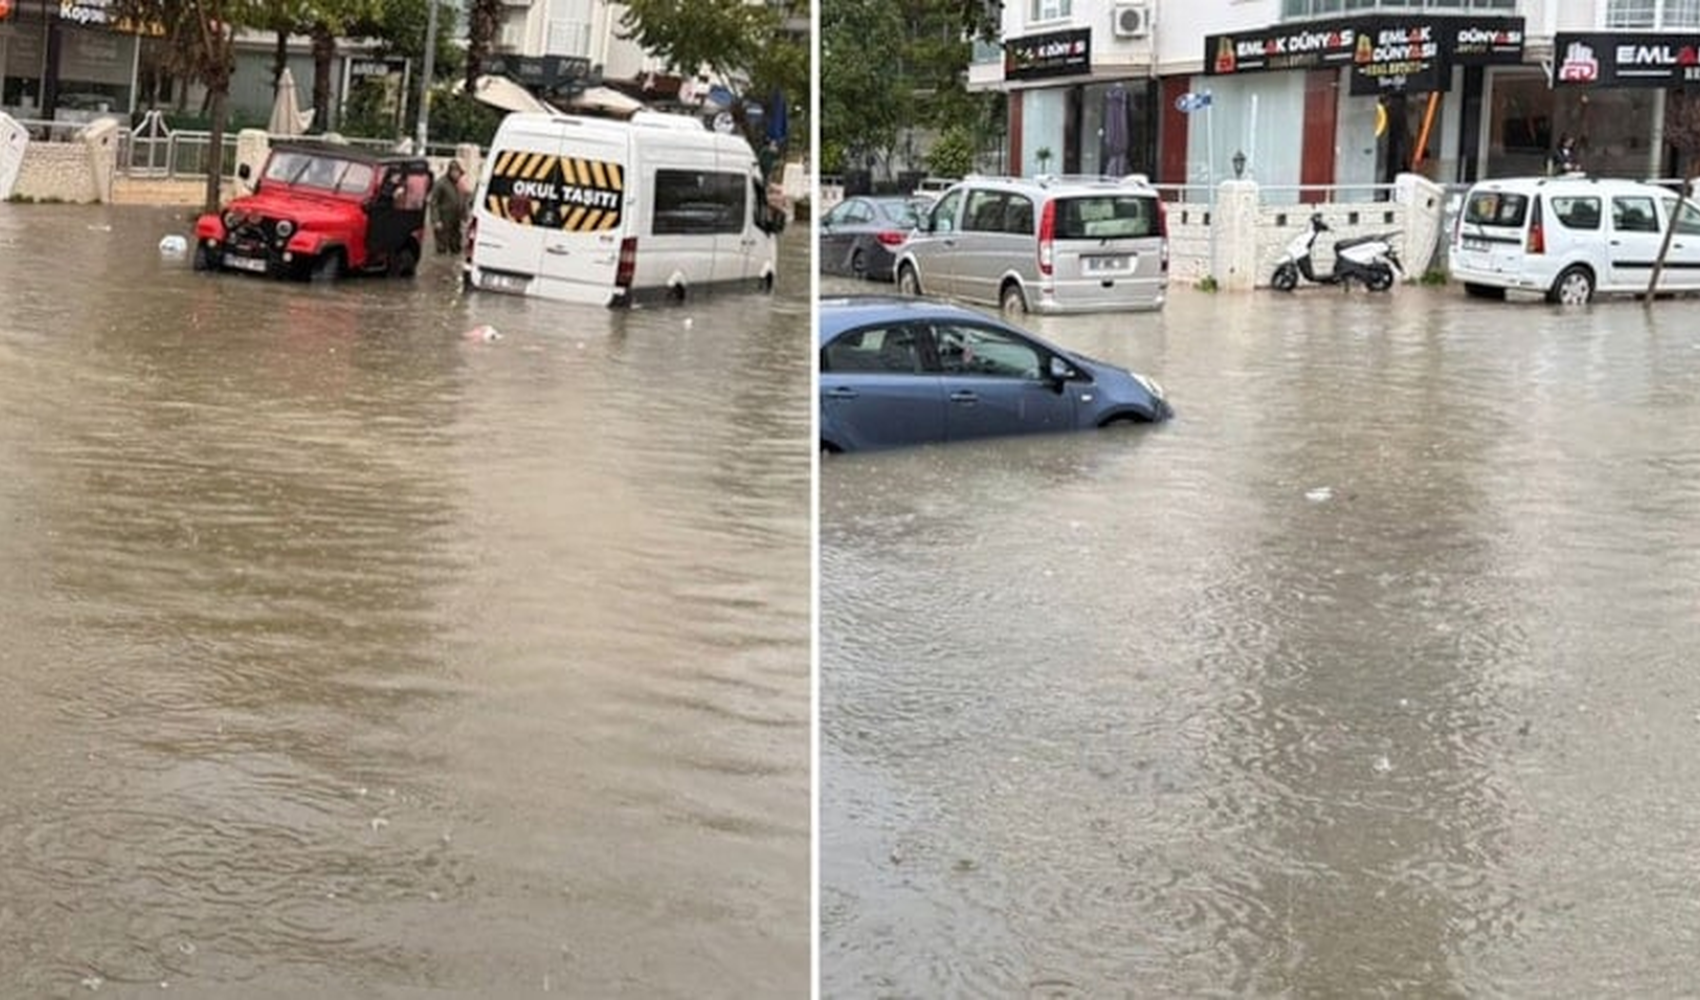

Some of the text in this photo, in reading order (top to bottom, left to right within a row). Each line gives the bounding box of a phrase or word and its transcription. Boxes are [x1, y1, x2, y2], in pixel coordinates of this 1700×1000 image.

[1378, 26, 1432, 45] EMLAK
[1457, 26, 1522, 43] DÜNYASI
[1236, 36, 1287, 58] EMLAK
[1372, 42, 1438, 62] DÜNYASI
[1615, 45, 1700, 64] EMLA
[512, 180, 619, 208] OKUL TAŞITI
